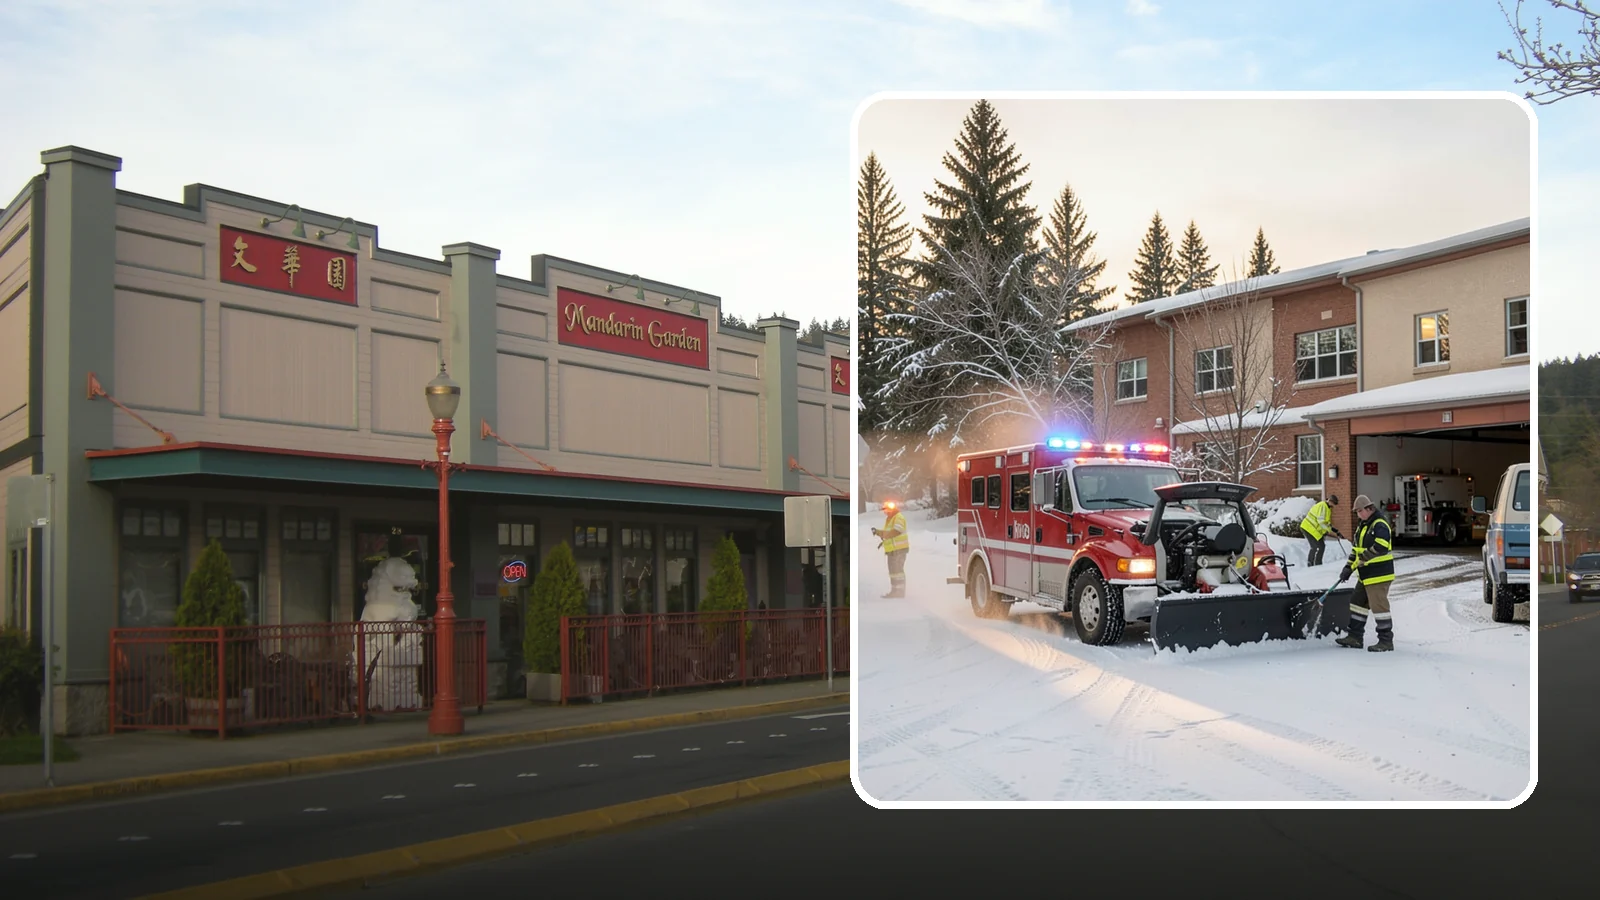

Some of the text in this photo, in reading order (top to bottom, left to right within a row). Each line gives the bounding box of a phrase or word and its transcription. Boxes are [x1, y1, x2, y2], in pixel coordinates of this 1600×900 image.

[230, 235, 346, 291] 文華園
[564, 302, 701, 352] Mandarin Garden
[503, 565, 527, 578] OPEN
